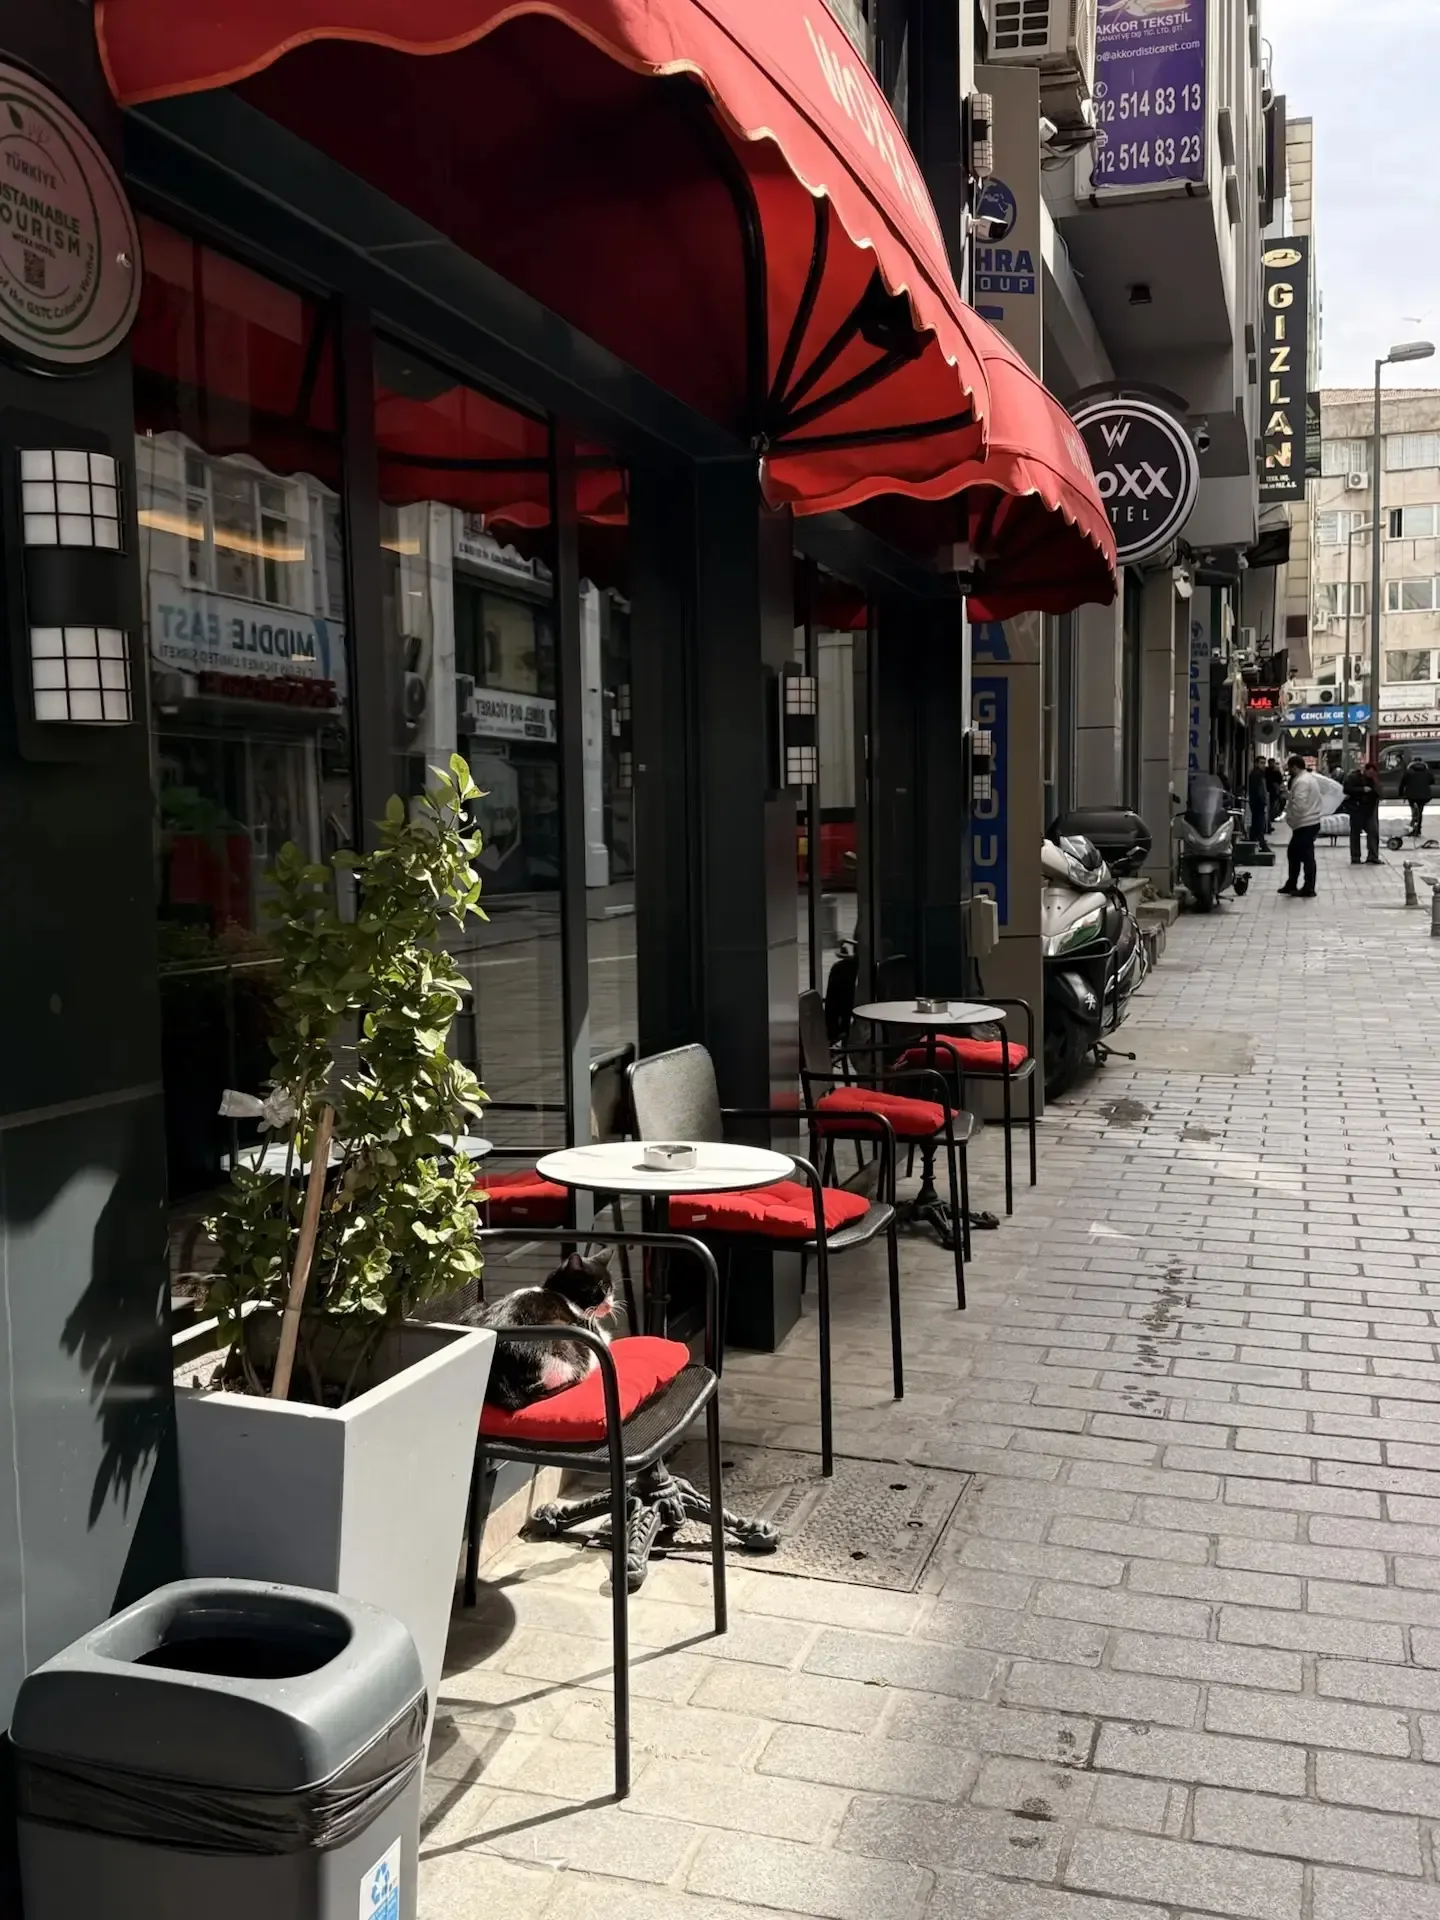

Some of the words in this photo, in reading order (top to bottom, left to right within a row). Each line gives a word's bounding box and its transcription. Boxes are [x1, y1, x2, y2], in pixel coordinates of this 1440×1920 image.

[1096, 20, 1138, 35] AKKOR
[1141, 11, 1192, 29] TEKSTİL
[1096, 39, 1201, 62] o@akkordisticaret.com
[1120, 90, 1150, 119] 514
[1155, 87, 1176, 115] 83
[1181, 83, 1201, 111] 13
[1096, 150, 1115, 173] 12
[1120, 141, 1150, 170] 514
[1154, 138, 1175, 166] 83
[1180, 135, 1201, 163] 23
[5, 151, 56, 190] TÜRKİYE
[26, 301, 52, 319] GSTC
[1264, 282, 1294, 468] GIZLAN
[1300, 711, 1331, 720] GENÇLİK
[1333, 711, 1351, 719] GID
[1382, 712, 1429, 723] CLASS
